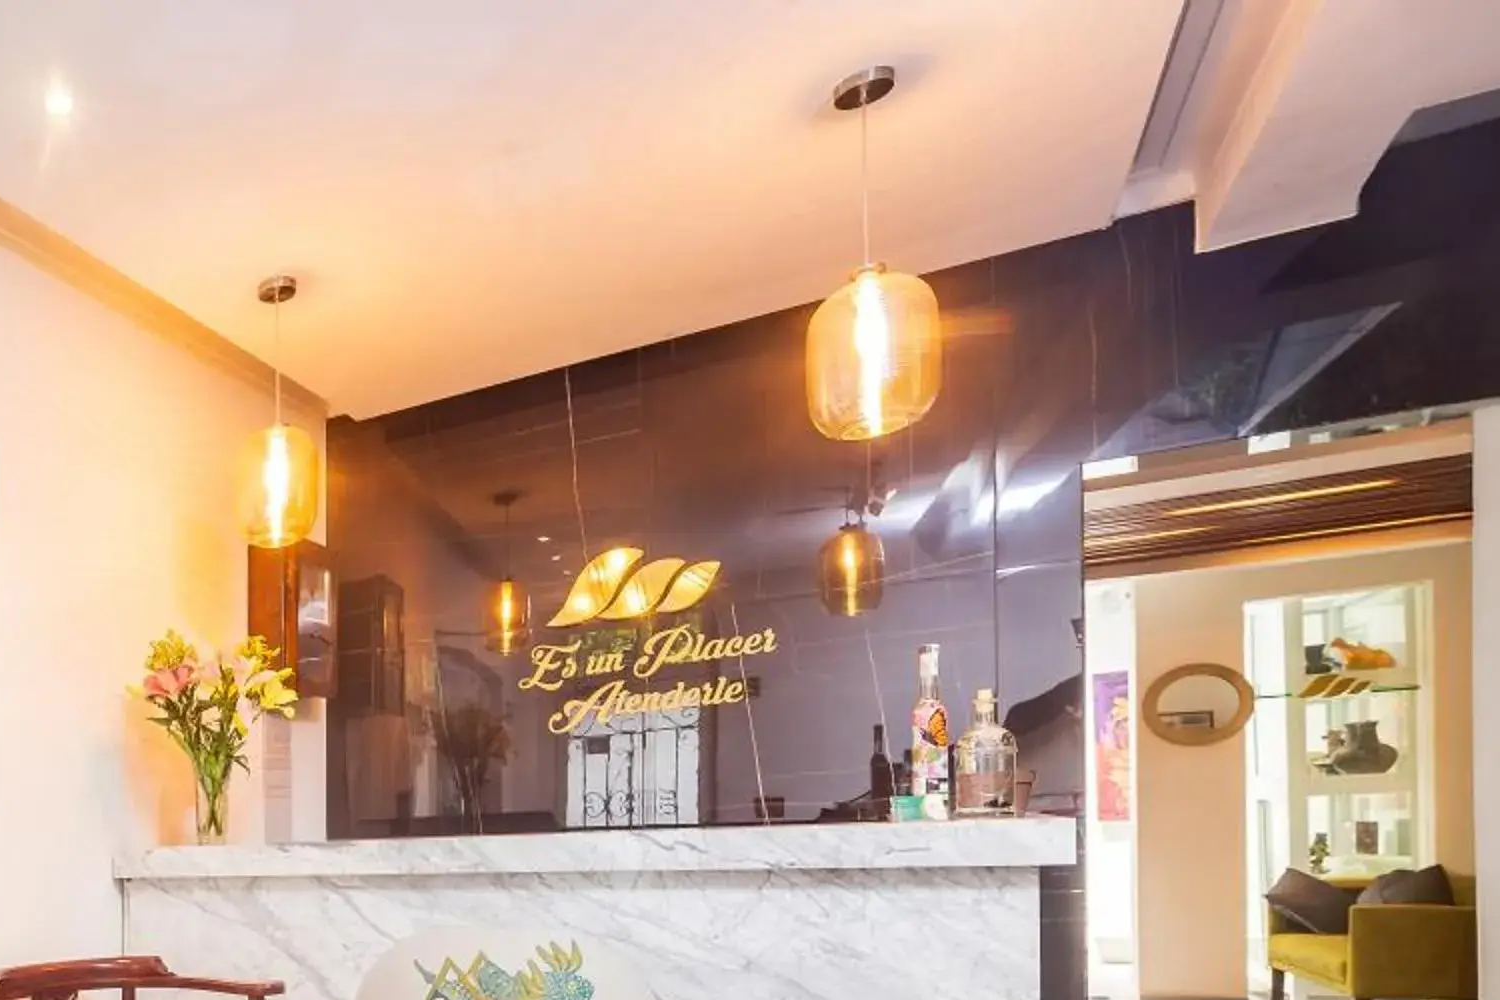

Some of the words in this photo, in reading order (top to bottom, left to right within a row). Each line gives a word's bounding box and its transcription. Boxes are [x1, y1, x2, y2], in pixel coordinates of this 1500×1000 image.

[518, 639, 582, 691] Es
[585, 650, 625, 676] un
[633, 623, 780, 679] Placer
[548, 676, 745, 735] Atenderle
